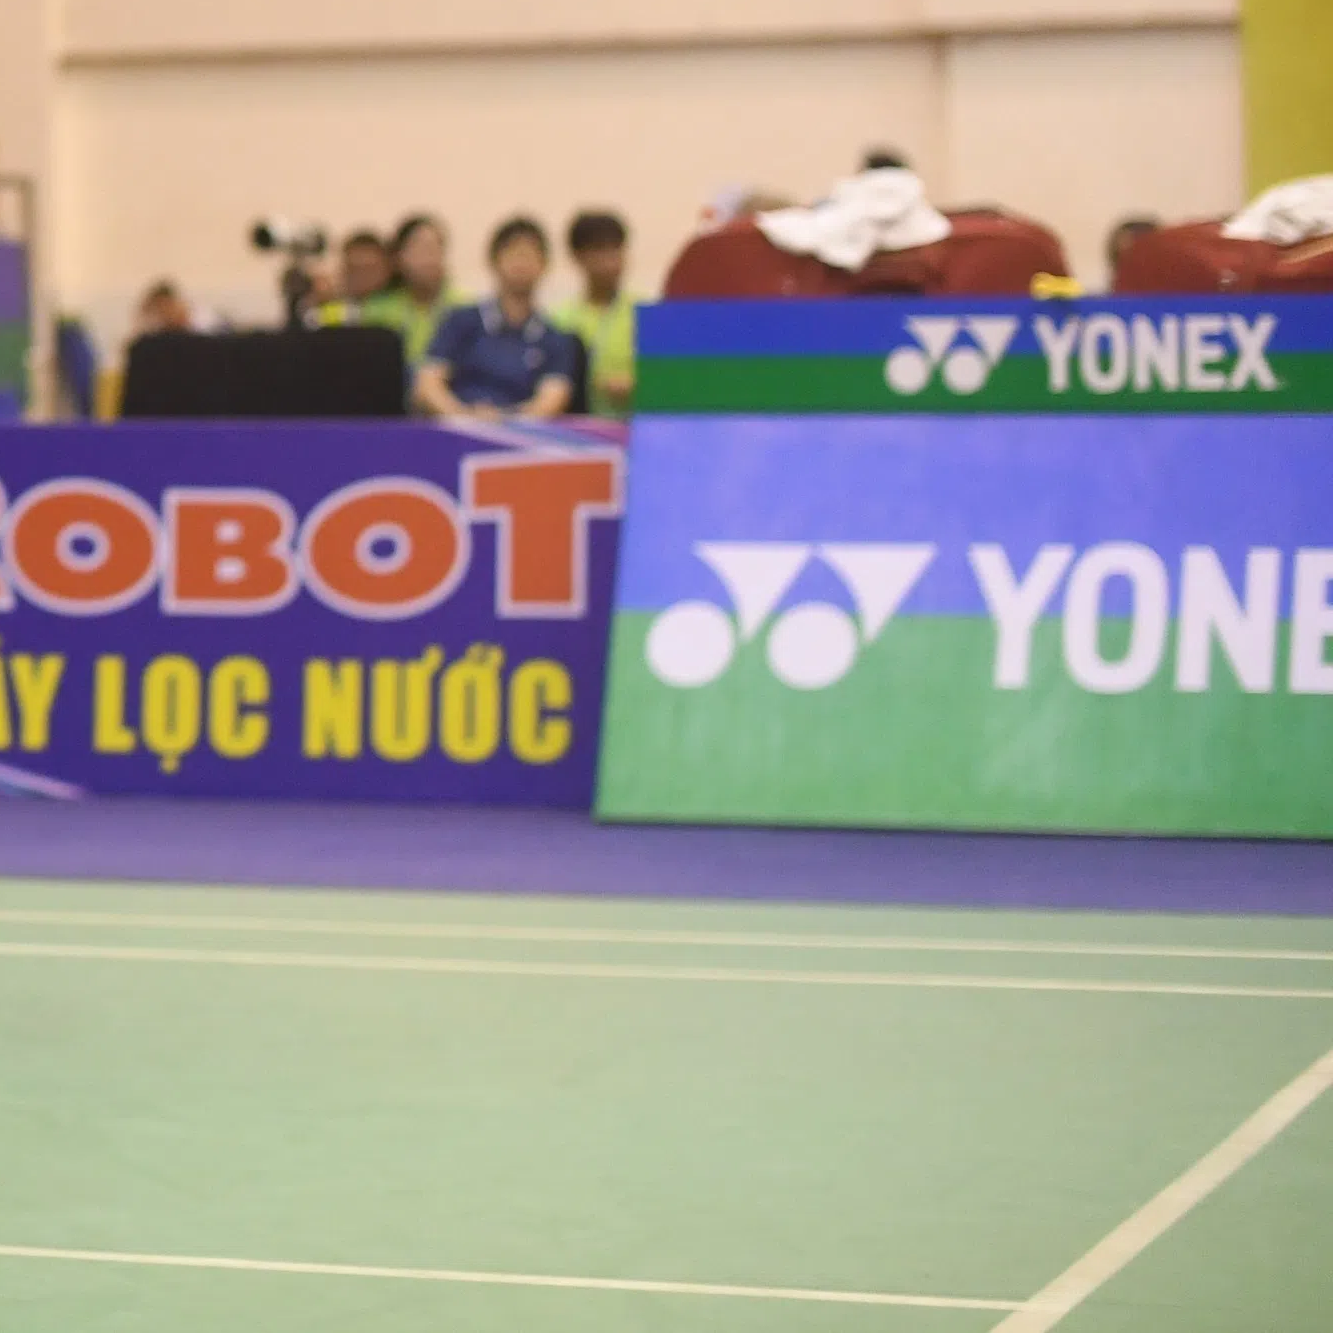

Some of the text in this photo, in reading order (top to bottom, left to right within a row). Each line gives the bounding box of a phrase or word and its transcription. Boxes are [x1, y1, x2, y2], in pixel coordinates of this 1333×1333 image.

[1034, 313, 1281, 394] YONEX
[93, 654, 271, 773] LỌC
[301, 644, 573, 763] NƯỚC
